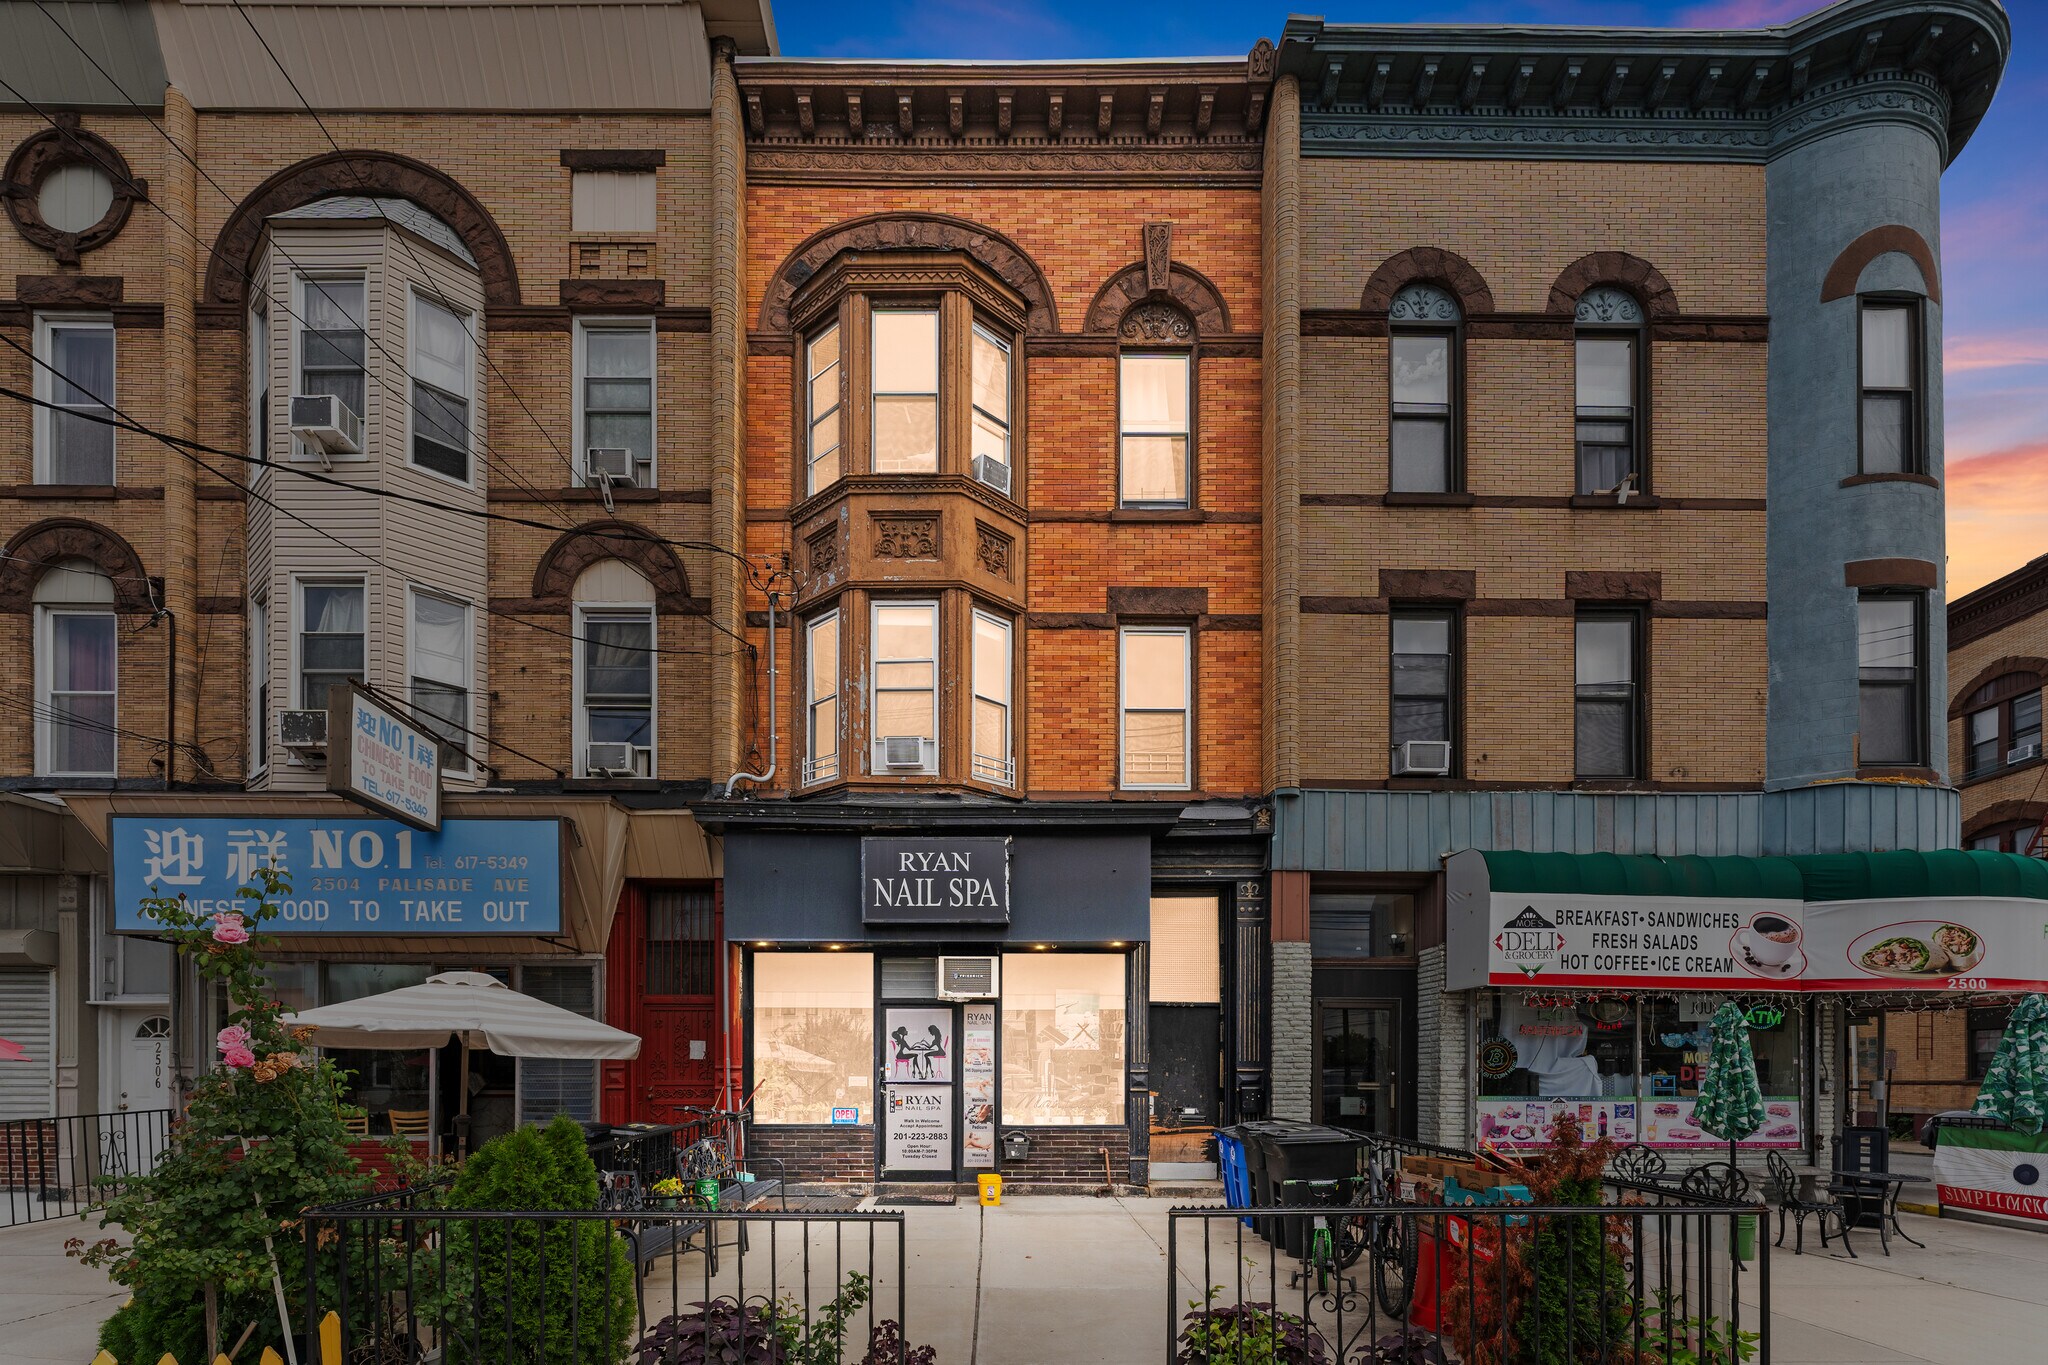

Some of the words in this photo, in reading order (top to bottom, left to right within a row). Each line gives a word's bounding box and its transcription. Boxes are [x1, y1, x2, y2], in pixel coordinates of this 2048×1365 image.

[379, 715, 415, 761] NO.1
[357, 734, 402, 774] CHINESE
[407, 762, 432, 790] FOOD
[361, 760, 376, 777] TO
[380, 769, 405, 792] TAKE
[409, 786, 428, 803] OUT
[310, 829, 413, 870] NO.1
[454, 856, 529, 871] 617-5349
[899, 852, 972, 872] RYAN
[311, 877, 360, 892] 2504
[379, 878, 473, 892] PALISADE
[493, 878, 529, 892] AVE
[873, 877, 943, 907] NAIL
[949, 877, 999, 907] SPA
[350, 900, 380, 922] TO
[403, 900, 463, 922] TAKE
[483, 900, 529, 922] OUT
[1555, 909, 1638, 927] BREAKFAST
[1647, 912, 1739, 929] SANDWICHES
[1515, 919, 1544, 928] MOE'S
[1505, 931, 1556, 951] DELI
[1592, 933, 1638, 949] FRESH
[1643, 934, 1698, 950] SALADS
[1511, 951, 1555, 960] GROCERY
[1560, 954, 1589, 970] HOT
[1594, 955, 1649, 971] COFFEE
[1657, 956, 1680, 972] ICE
[1685, 957, 1734, 973] CREAM
[1947, 978, 1987, 989] 2500
[967, 1013, 992, 1021] RYAN
[1744, 1009, 1782, 1025] ATM
[905, 1095, 942, 1105] RYAN
[835, 1109, 855, 1119] OPEN
[893, 1132, 948, 1140] 201-223-2883
